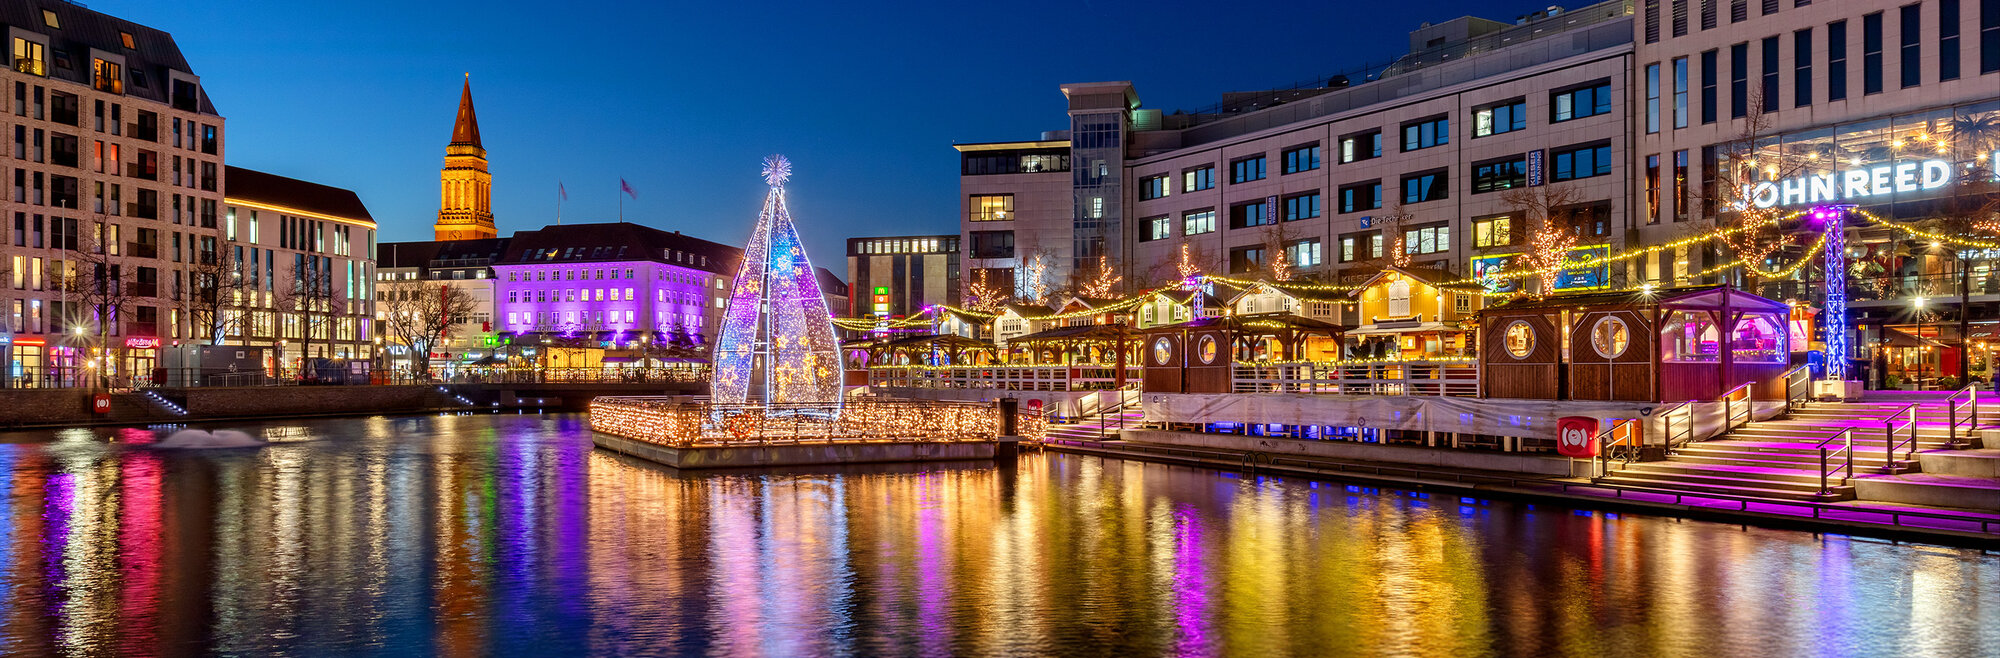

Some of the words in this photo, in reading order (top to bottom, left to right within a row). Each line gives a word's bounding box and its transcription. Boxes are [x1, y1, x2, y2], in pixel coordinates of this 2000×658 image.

[1734, 174, 1835, 210] JOHN
[1845, 160, 1951, 198] REED
[386, 345, 409, 355] NLY
